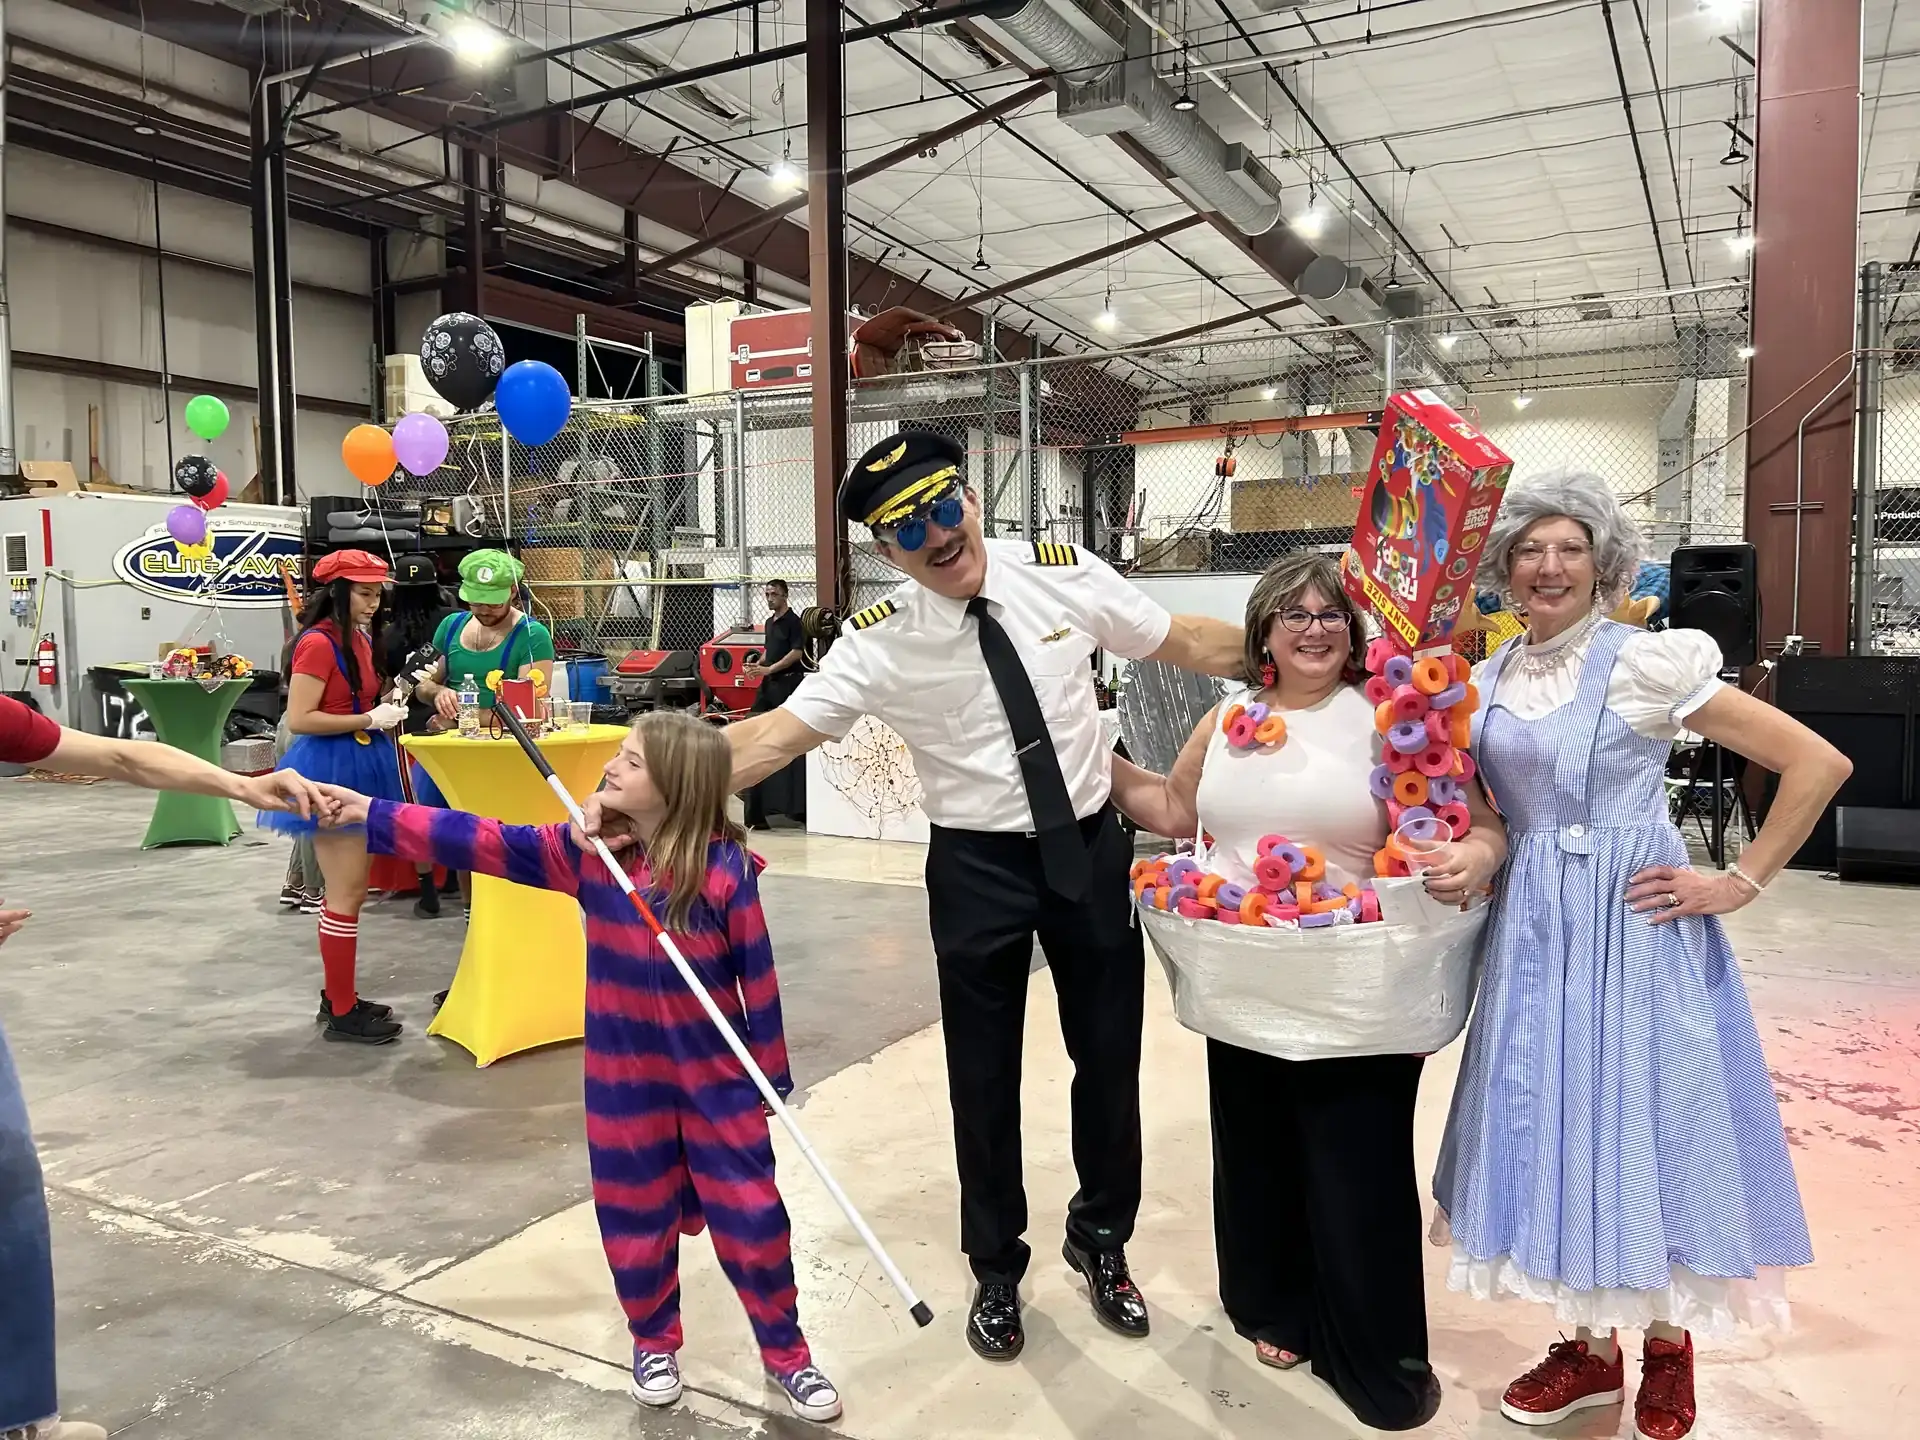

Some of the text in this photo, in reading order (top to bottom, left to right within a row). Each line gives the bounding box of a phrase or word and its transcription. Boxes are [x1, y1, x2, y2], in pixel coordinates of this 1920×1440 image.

[1466, 505, 1492, 518] NOSE
[1464, 513, 1489, 526] YOUR
[144, 554, 220, 574] ELITE
[409, 565, 419, 578] P
[480, 568, 489, 581] L
[1366, 580, 1388, 608] SIZE
[1387, 606, 1417, 643] GIANT
